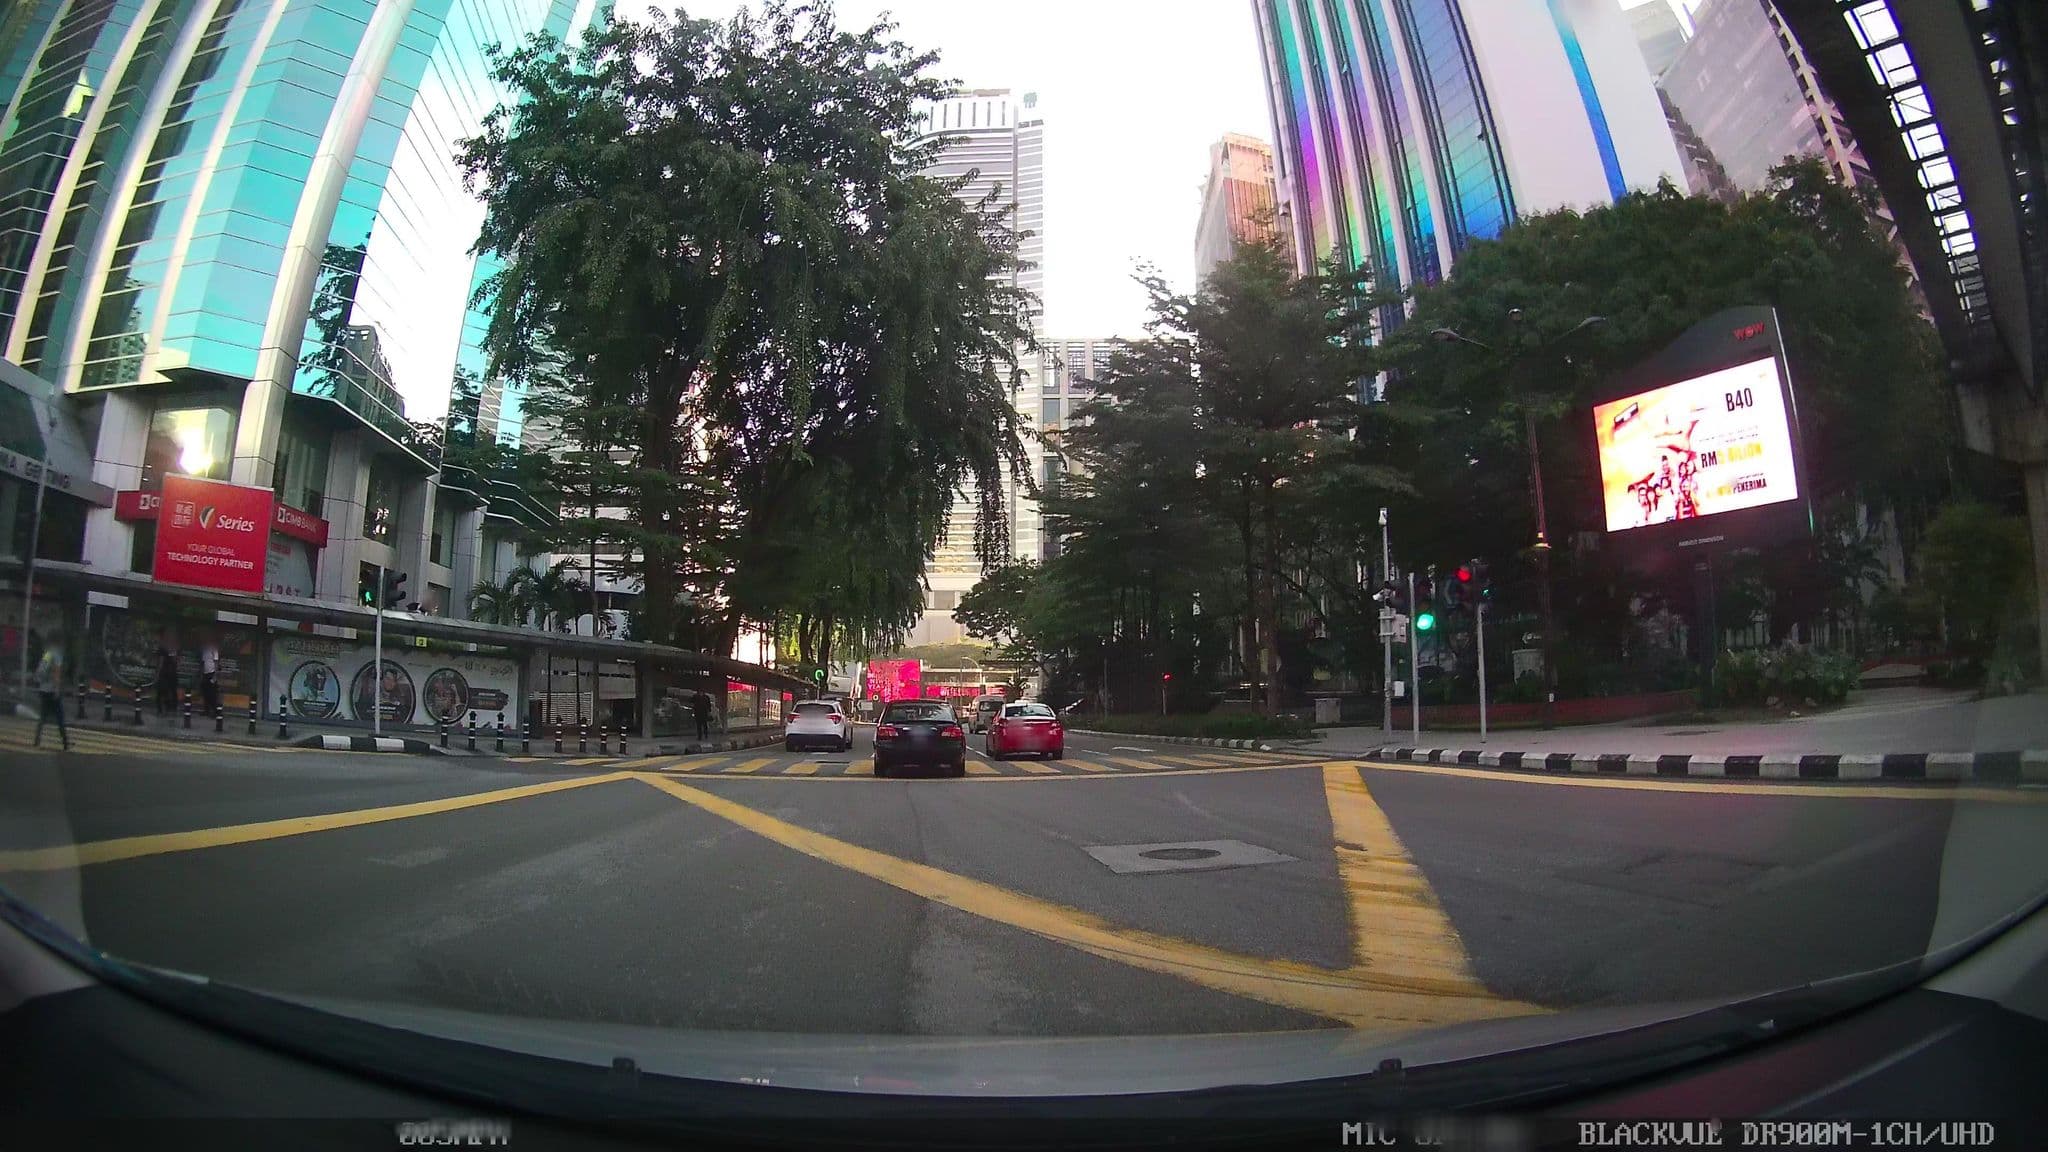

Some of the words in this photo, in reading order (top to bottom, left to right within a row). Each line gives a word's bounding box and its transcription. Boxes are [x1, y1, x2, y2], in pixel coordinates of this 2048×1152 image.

[1725, 387, 1753, 412] B40
[216, 514, 255, 533] Series
[187, 543, 207, 553] YOUR
[207, 545, 235, 557] GLOBAL
[167, 551, 218, 566] TECHNOLOGY
[219, 558, 254, 570] PARTNER
